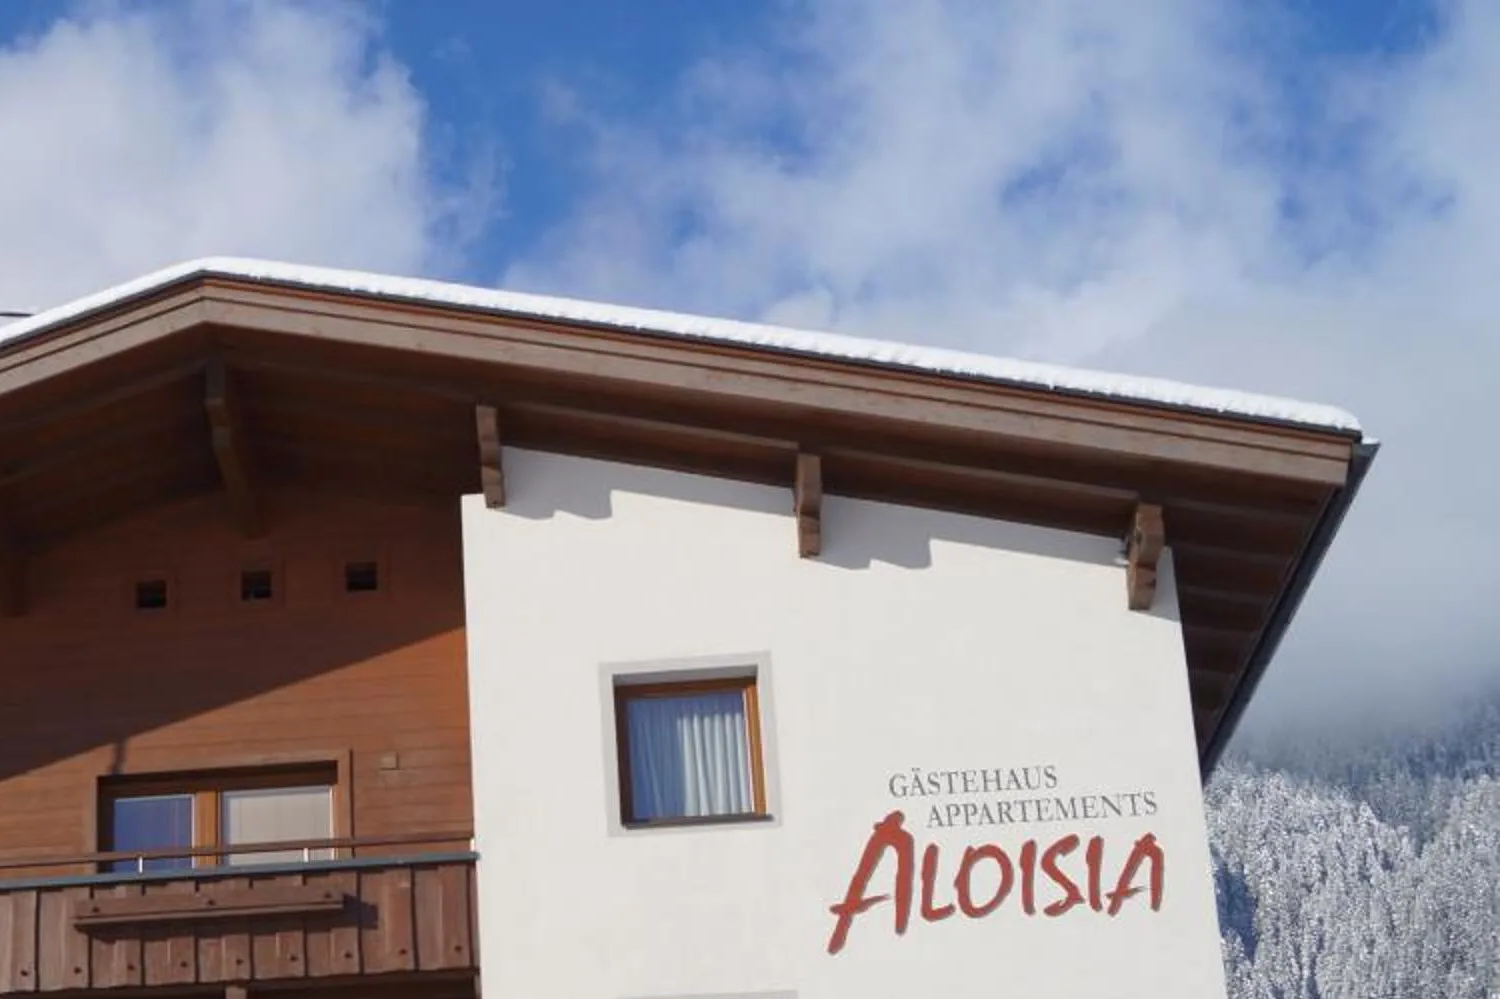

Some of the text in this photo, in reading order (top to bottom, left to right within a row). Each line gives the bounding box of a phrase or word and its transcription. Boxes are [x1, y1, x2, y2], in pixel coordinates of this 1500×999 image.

[888, 764, 1058, 798] GÄSTEHAUS
[926, 791, 1158, 829] APPARTEMENTS
[827, 809, 1165, 955] ALOISIA
